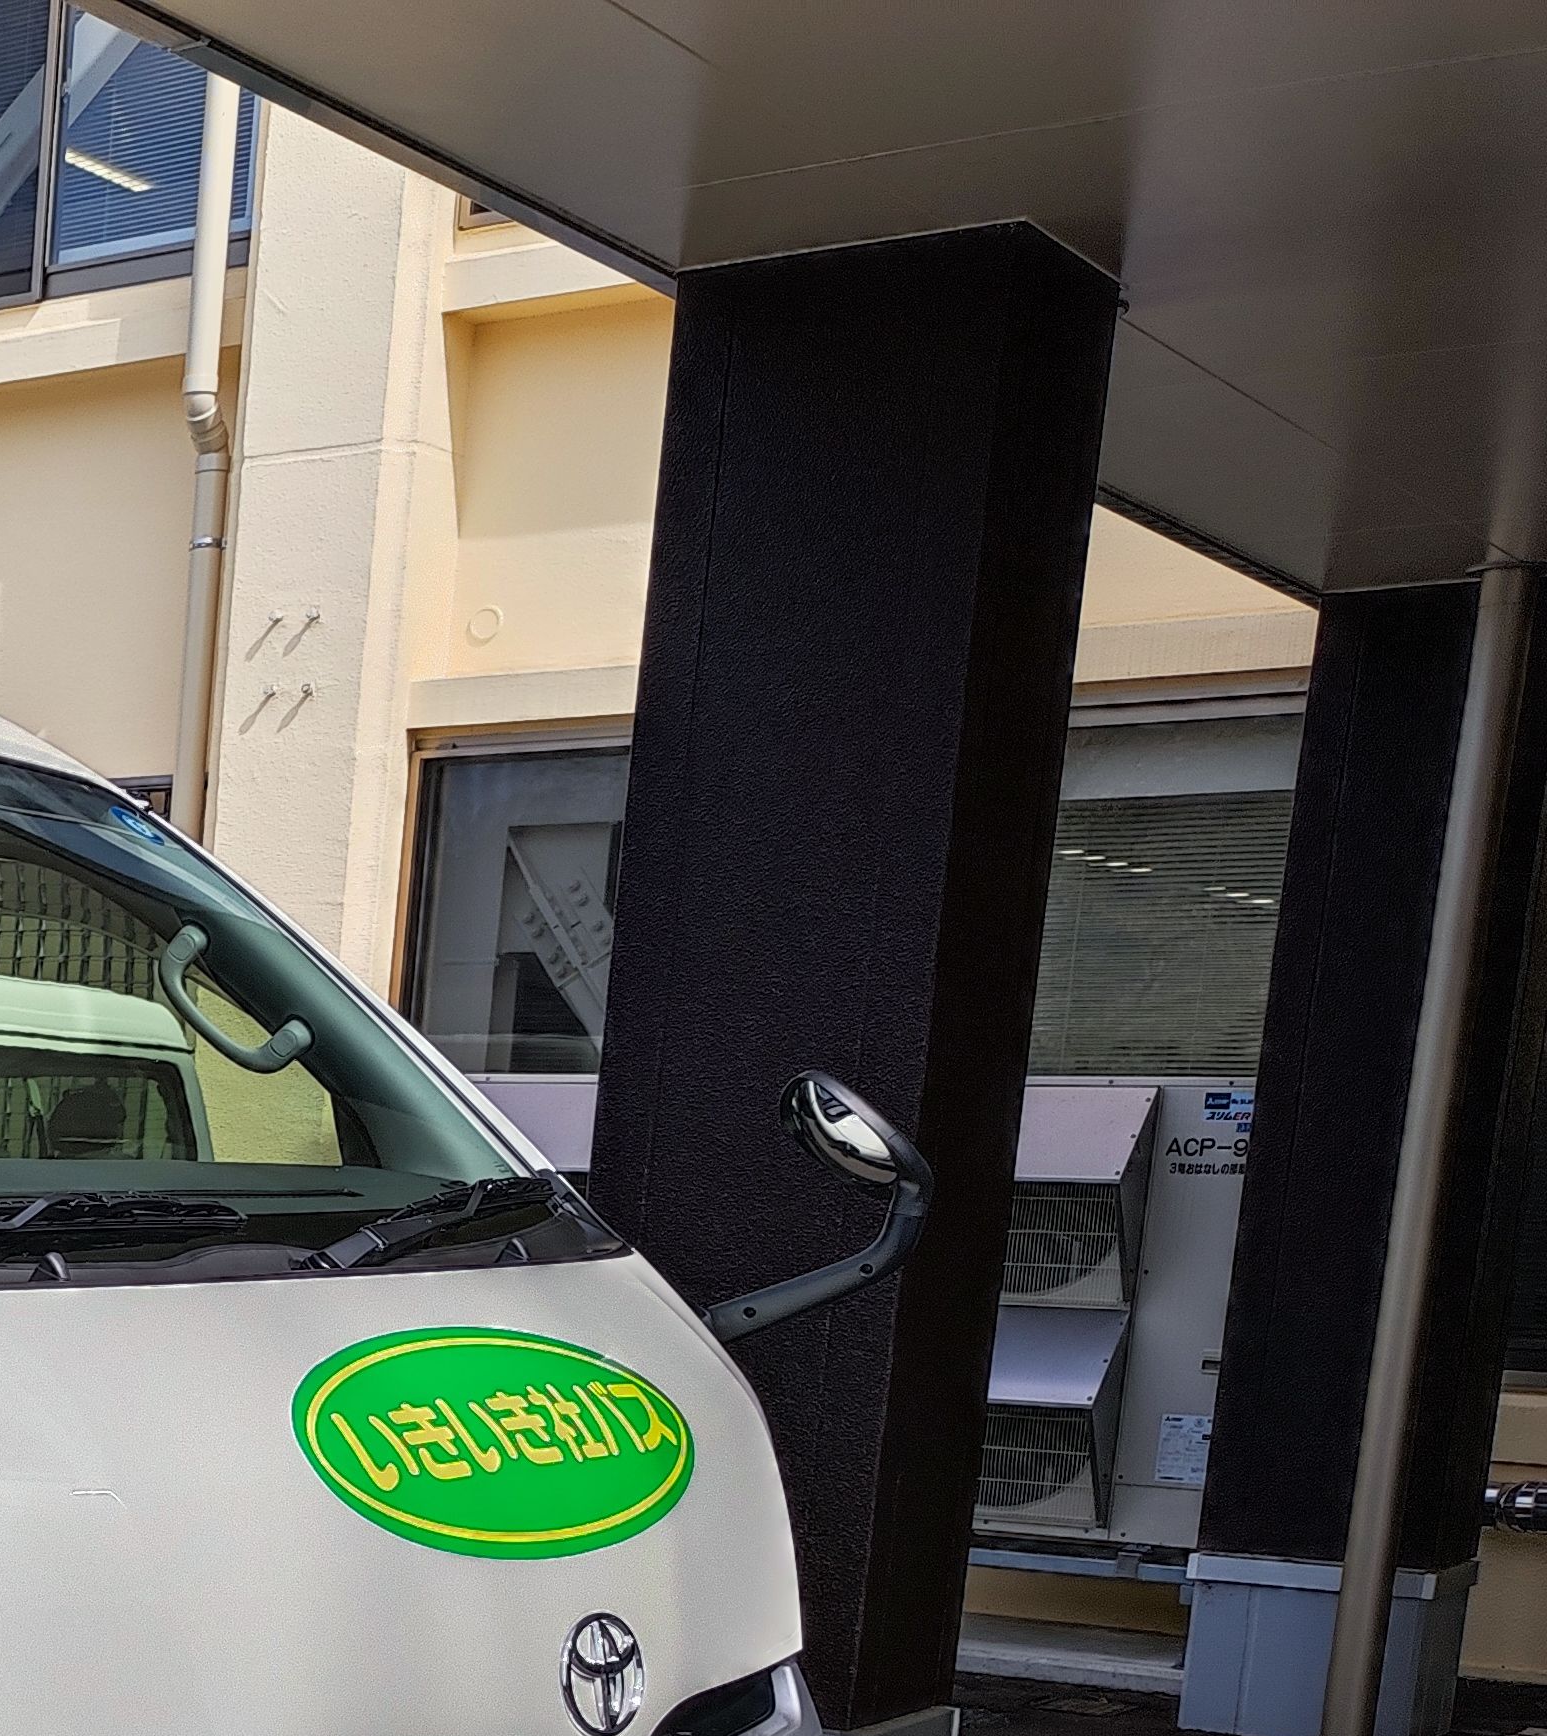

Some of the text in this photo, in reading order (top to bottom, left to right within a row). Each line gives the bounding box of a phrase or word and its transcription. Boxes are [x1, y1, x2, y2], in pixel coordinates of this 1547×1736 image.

[330, 1381, 678, 1492] いきいき社バス
